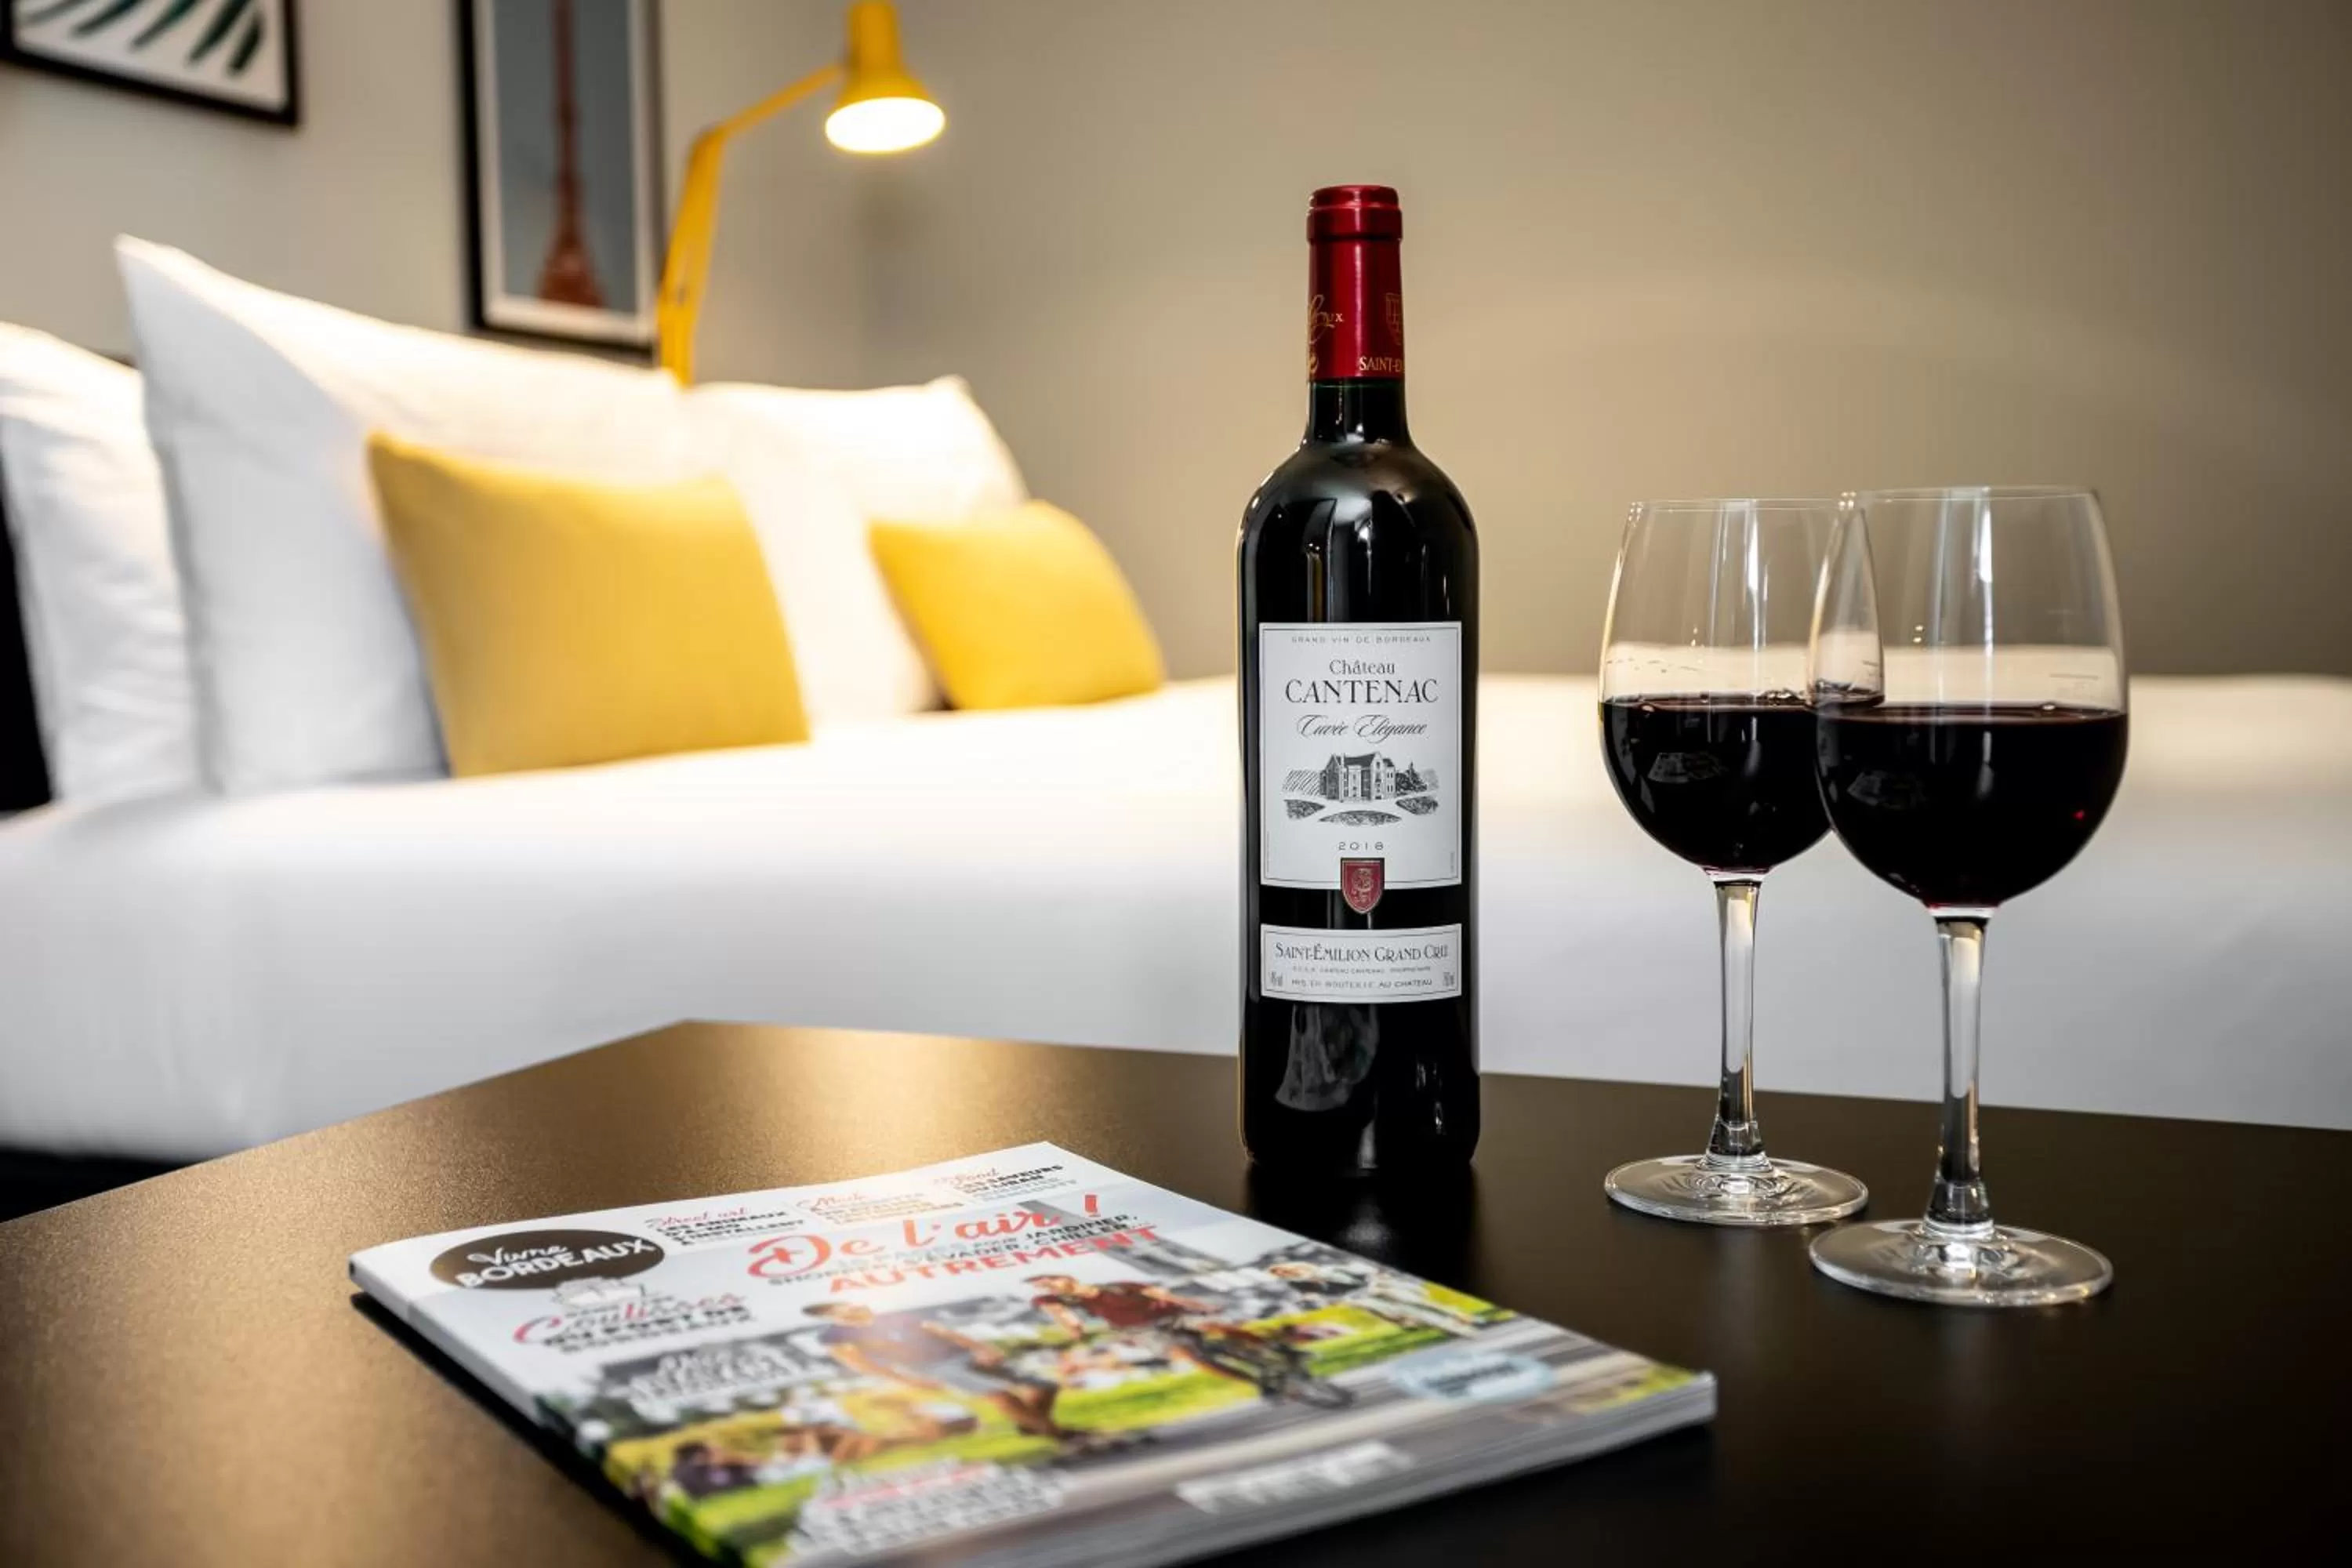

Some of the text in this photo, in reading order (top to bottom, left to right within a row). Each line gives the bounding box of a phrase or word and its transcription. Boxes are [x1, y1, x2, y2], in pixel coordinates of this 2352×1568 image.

[1291, 635, 1431, 644] GRAND VIN DE BORDEAUX
[1329, 659, 1396, 675] Château
[1284, 678, 1439, 703] CANTENAC
[1297, 714, 1349, 738] Cuvée
[1338, 841, 1385, 851] 2018
[1275, 942, 1449, 963] SAINT-ÉMILION GRAND CRU
[455, 1239, 658, 1287] BORDEAUX
[746, 1232, 886, 1279] De
[829, 1223, 1158, 1294] AUTREMENT
